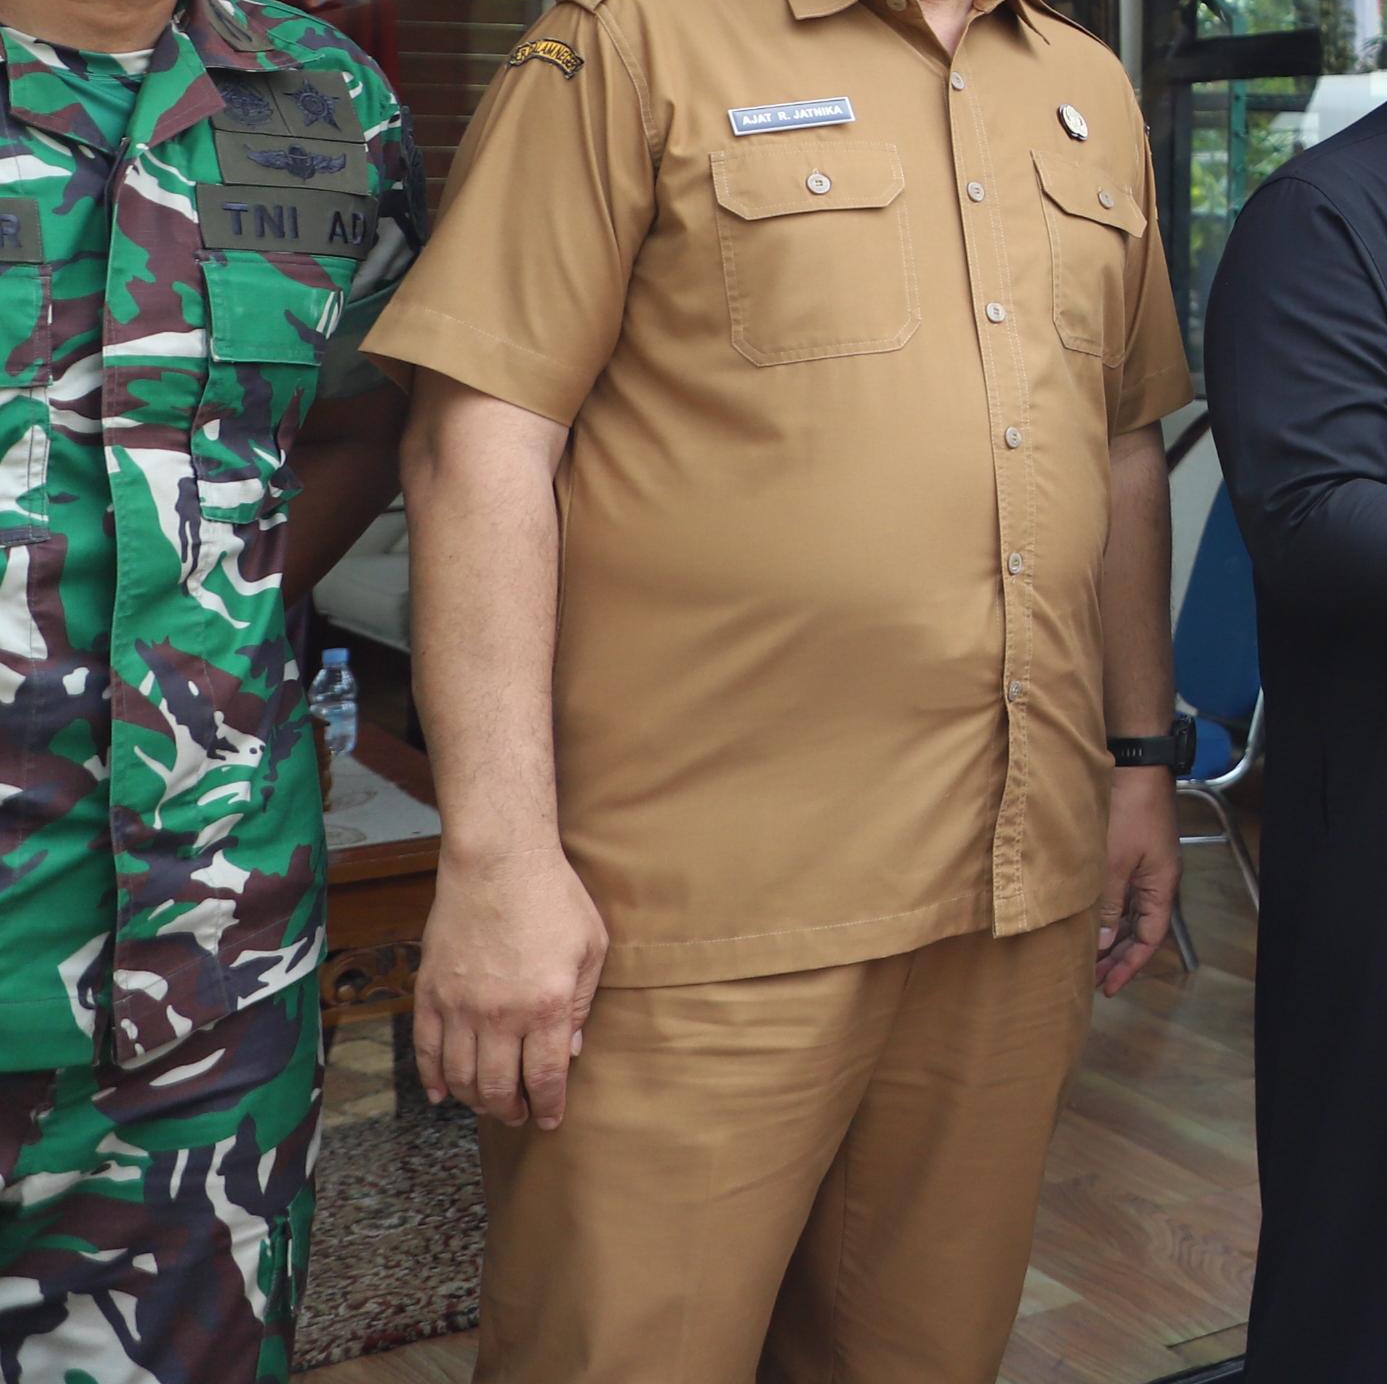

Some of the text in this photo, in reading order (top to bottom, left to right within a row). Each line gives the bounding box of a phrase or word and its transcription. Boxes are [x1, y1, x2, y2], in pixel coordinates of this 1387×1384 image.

[742, 105, 843, 126] AJAT R. JATNIKA
[223, 201, 367, 245] TNI AD
